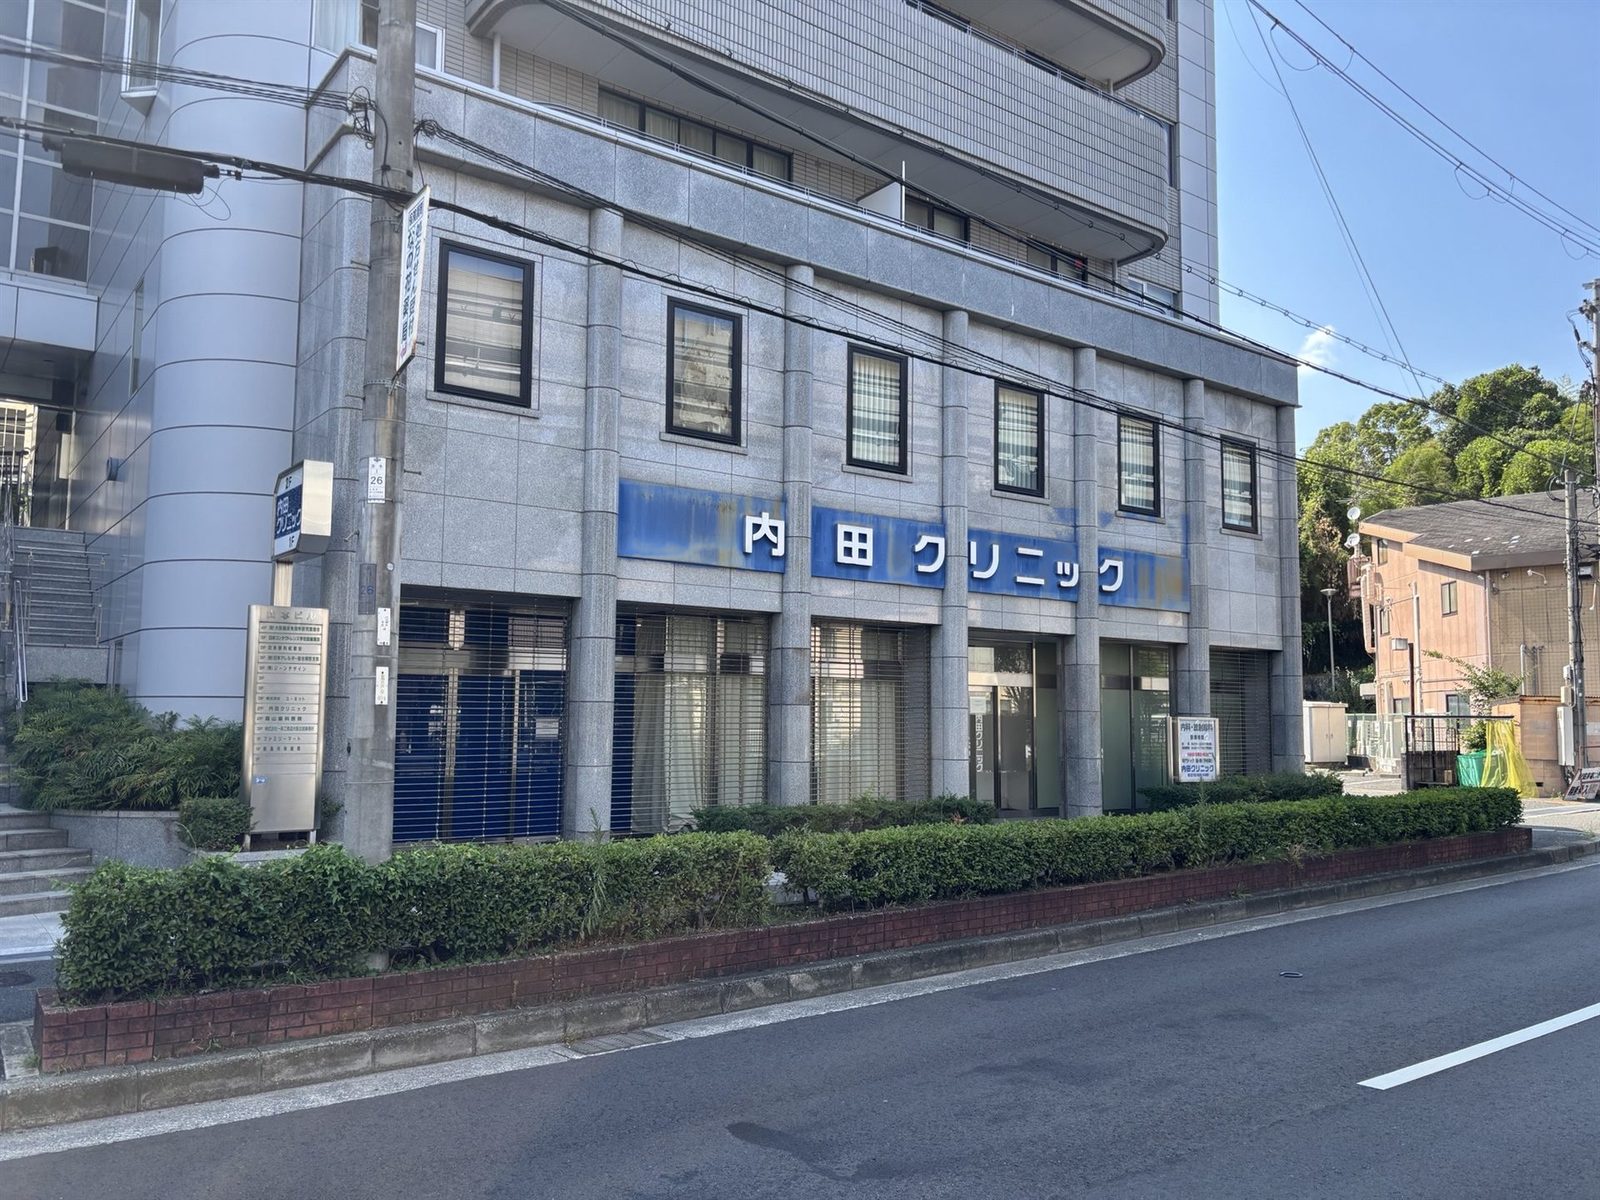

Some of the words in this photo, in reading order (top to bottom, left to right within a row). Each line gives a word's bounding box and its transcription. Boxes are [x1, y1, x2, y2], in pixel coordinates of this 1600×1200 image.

[370, 476, 383, 485] 26
[277, 497, 289, 516] 内田
[276, 509, 302, 535] クリニック
[744, 512, 1124, 592] 内田クリニック
